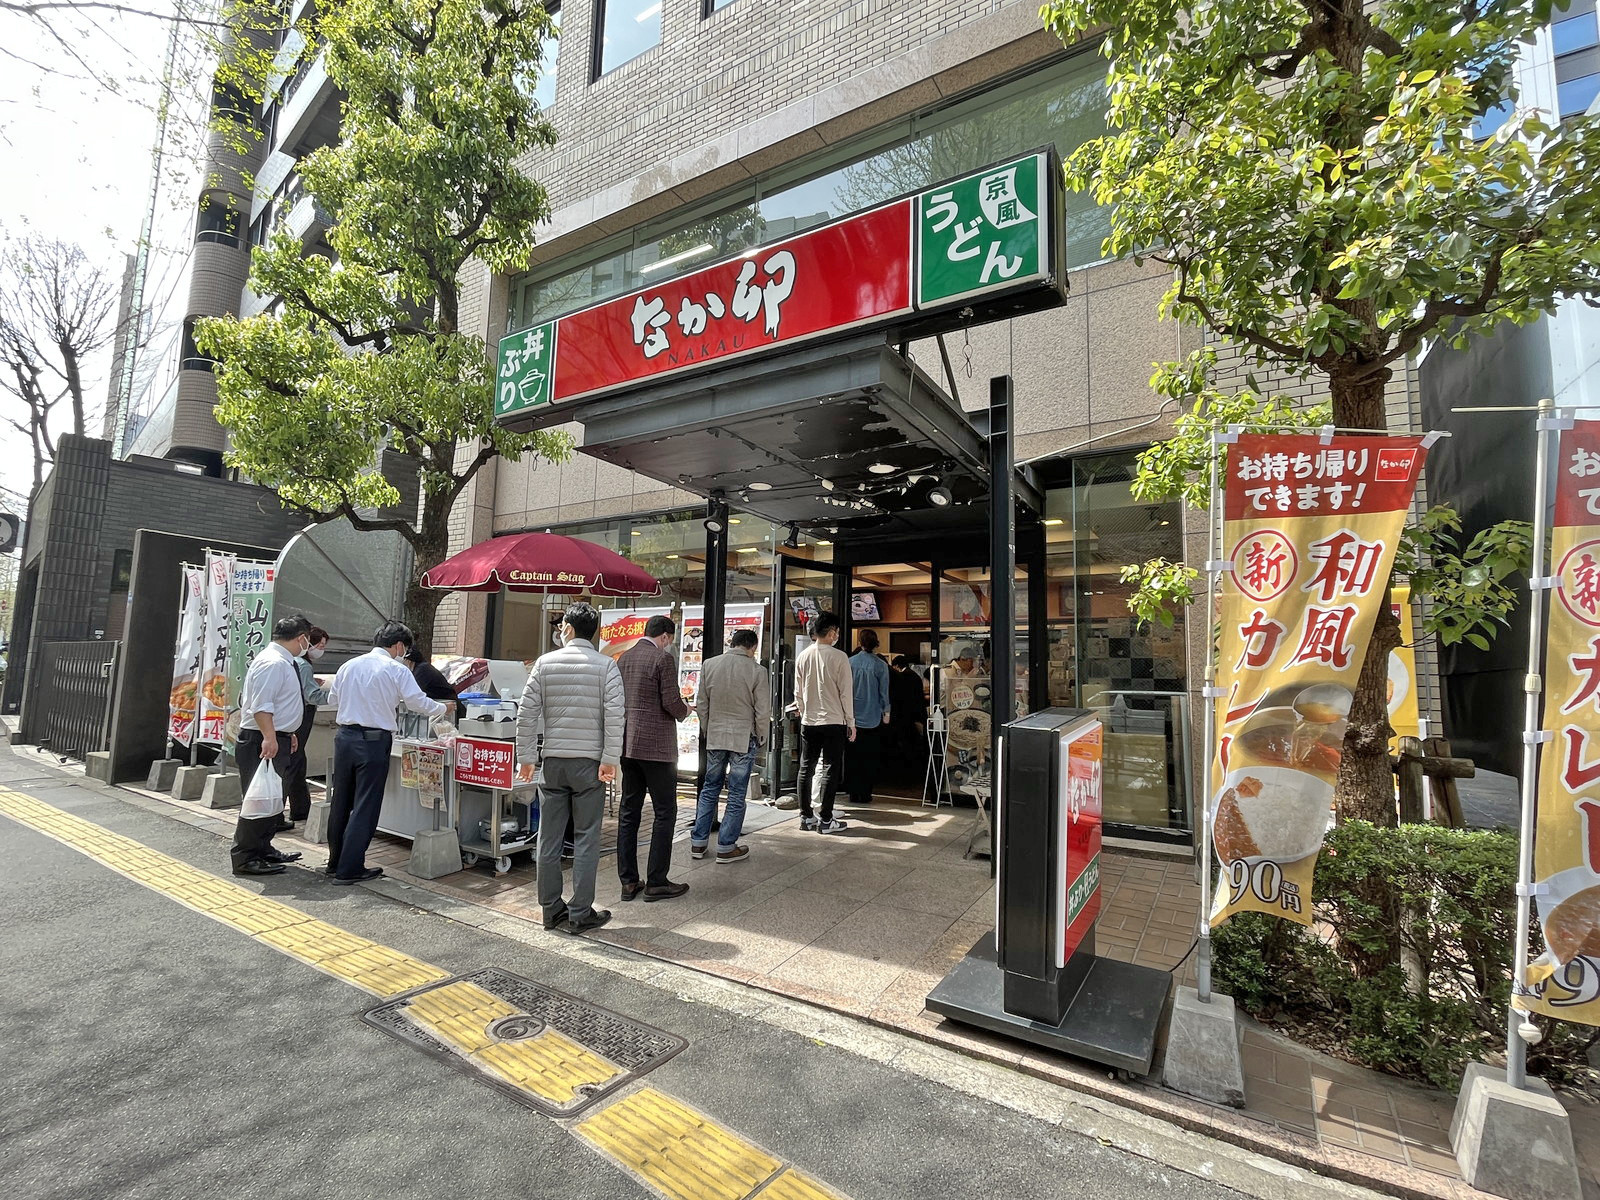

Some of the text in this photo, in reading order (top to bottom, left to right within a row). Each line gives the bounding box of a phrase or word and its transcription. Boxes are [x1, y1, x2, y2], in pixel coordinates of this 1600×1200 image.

[985, 175, 1020, 225] 京風
[926, 191, 1023, 283] うどん
[630, 250, 797, 358] なか卯
[667, 333, 746, 365] NAKAU
[1237, 448, 1369, 481] お持ち帰り
[234, 569, 265, 580] お持ち帰り
[510, 570, 586, 584] Captain Stag
[1243, 541, 1287, 592] 新
[1281, 531, 1384, 668] 和風
[601, 620, 647, 640] 新たなる挑
[474, 748, 511, 764] お持ち帰り
[477, 761, 506, 774] コーナー
